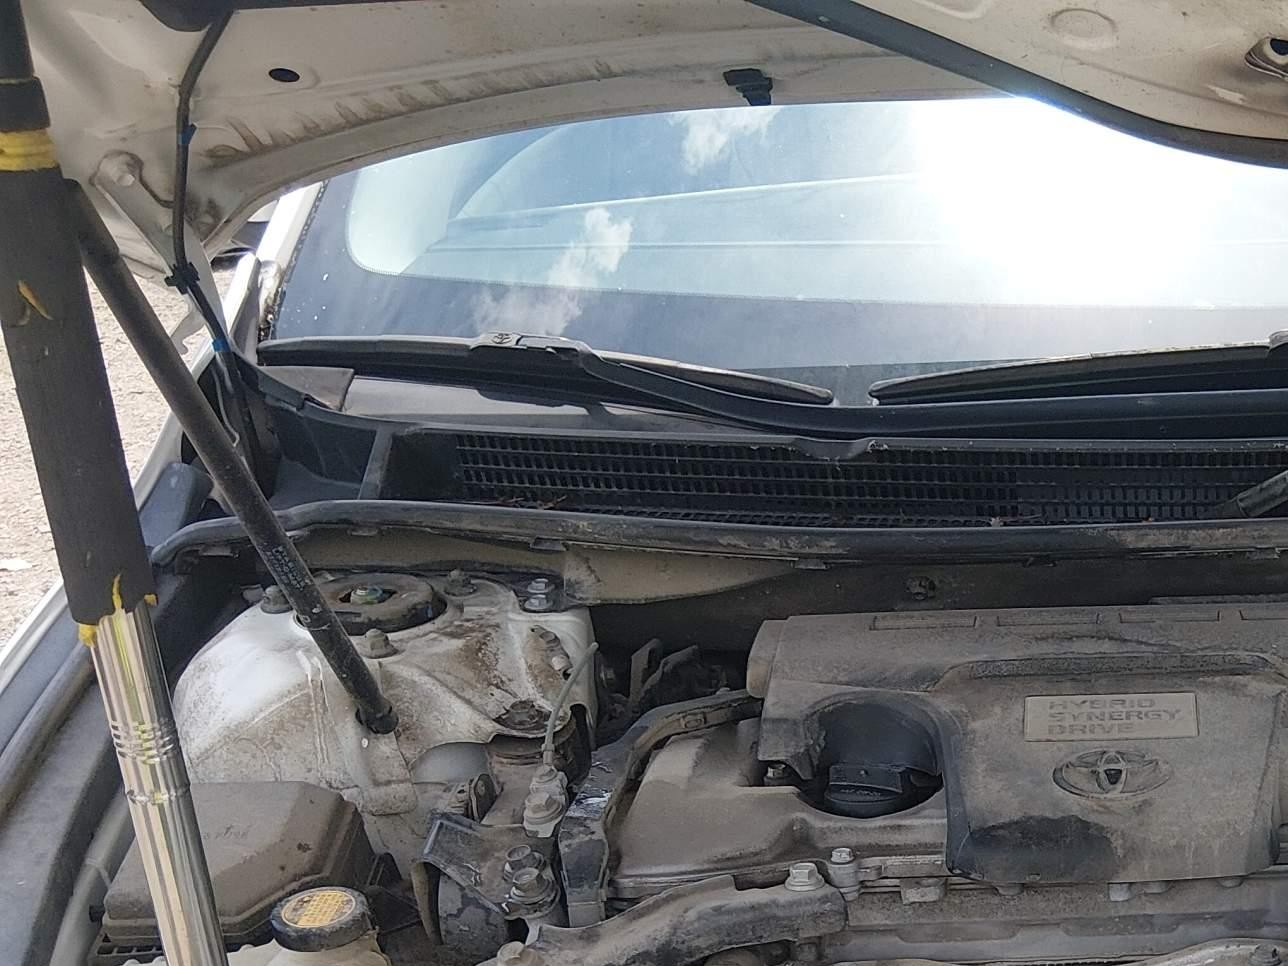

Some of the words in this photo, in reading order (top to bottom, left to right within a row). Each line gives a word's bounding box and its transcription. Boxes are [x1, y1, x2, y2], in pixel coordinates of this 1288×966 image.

[1049, 699, 1156, 710] HYBRID
[1049, 709, 1182, 723] SYNERGY
[1048, 722, 1137, 735] DRIVE
